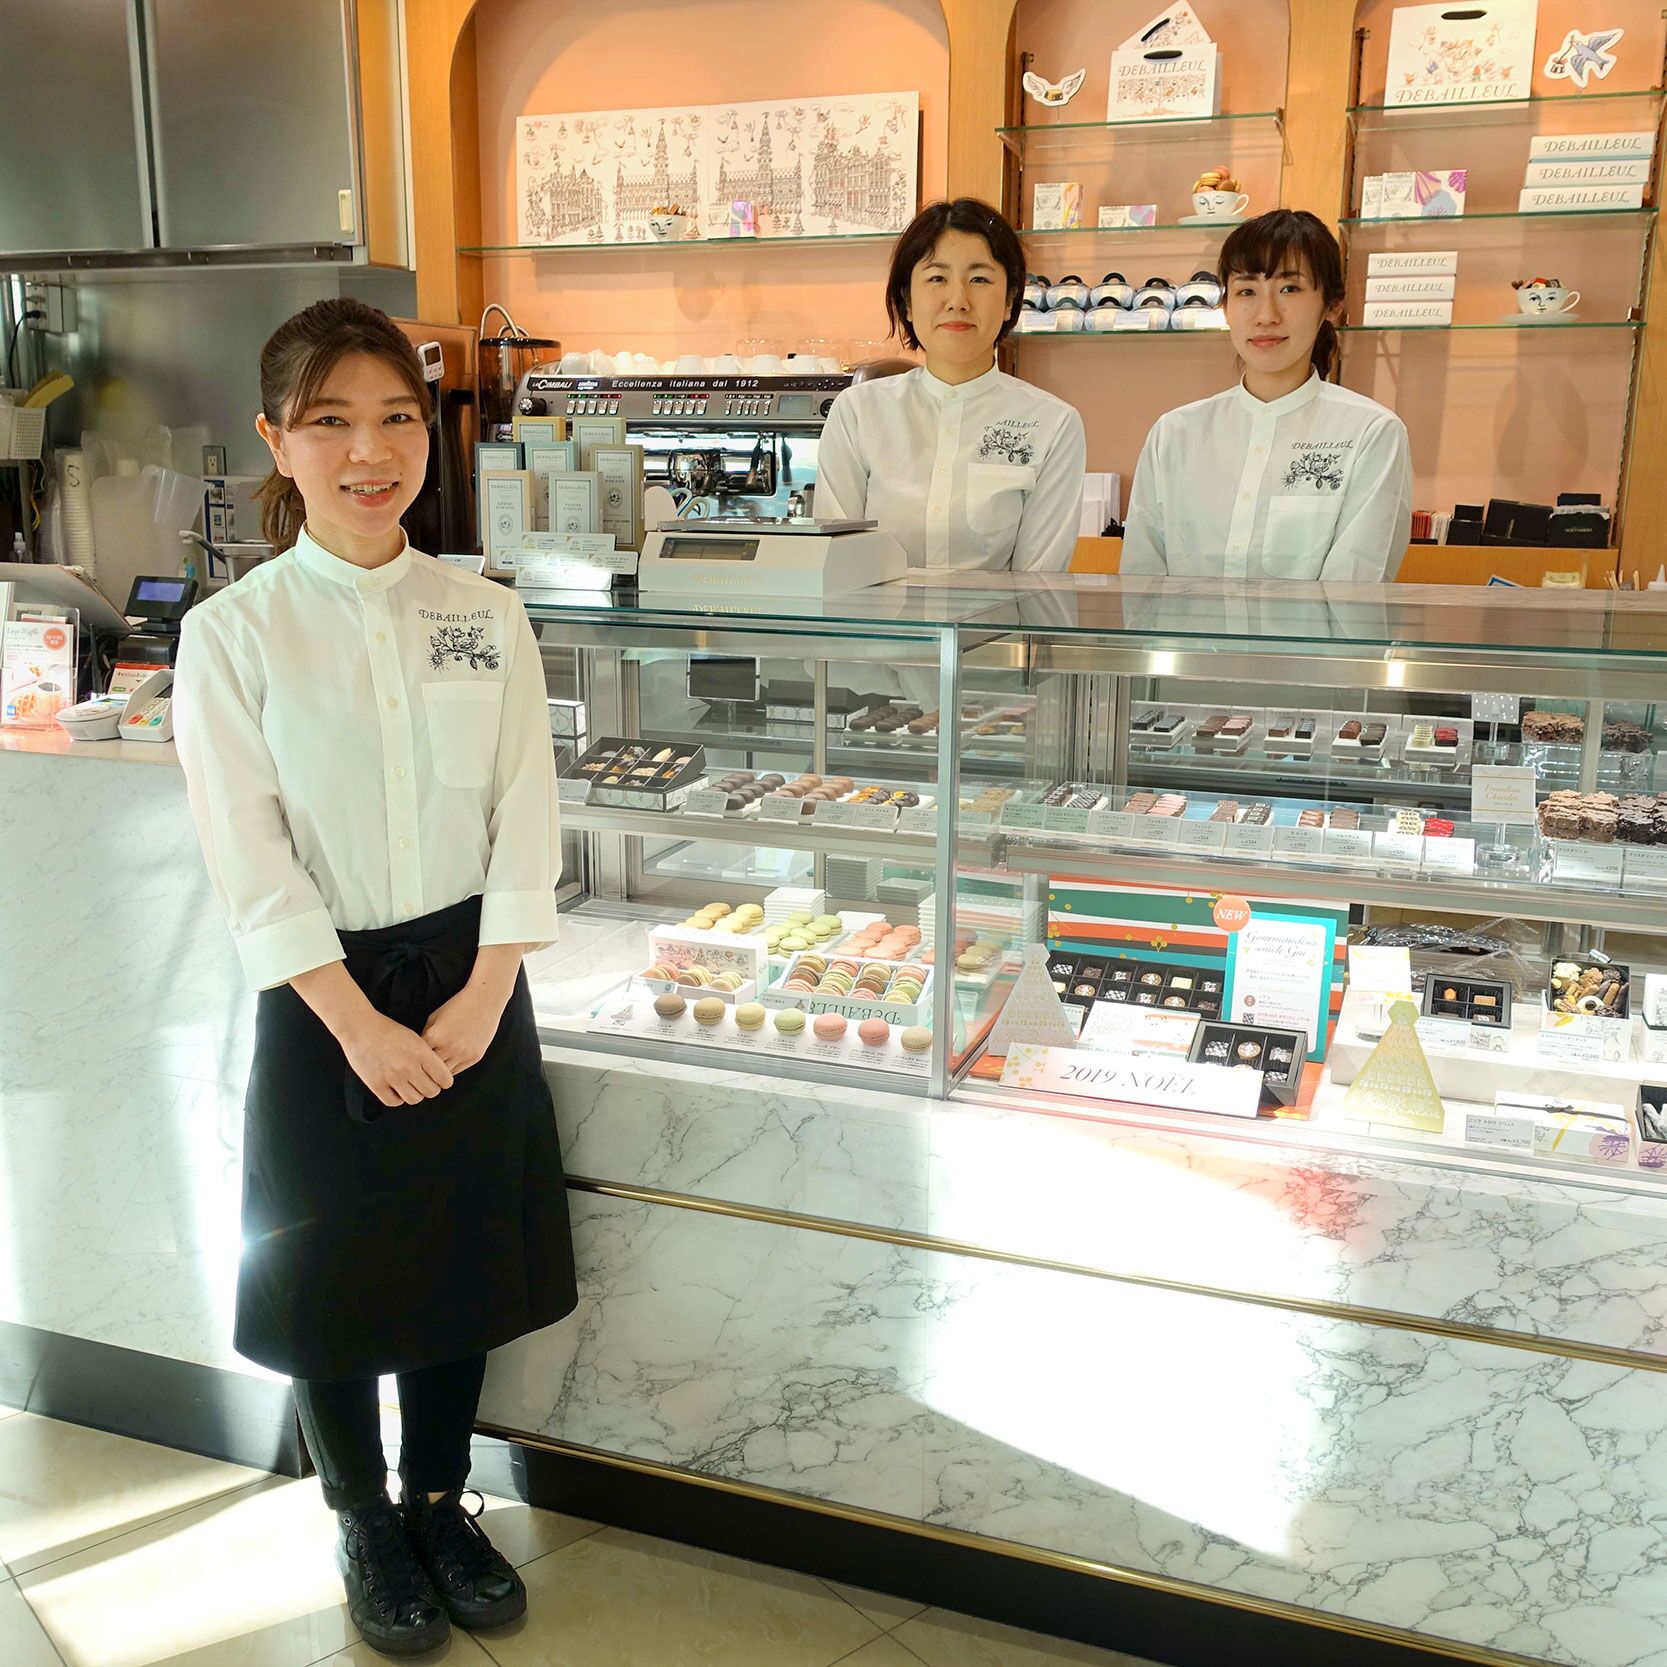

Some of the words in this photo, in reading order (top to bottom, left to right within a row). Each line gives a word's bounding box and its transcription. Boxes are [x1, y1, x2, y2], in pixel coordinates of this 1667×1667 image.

[1120, 60, 1207, 76] DEBAILLEUL
[1395, 83, 1518, 103] DEBAILLEUL
[1544, 138, 1642, 152] DEBAILLEUL
[1540, 165, 1637, 179] DEBAILLEUL
[1533, 191, 1630, 205] DEBAILLEUL
[1377, 257, 1448, 268] DEBAILLEUL
[1374, 282, 1445, 293] DEBAILLEUL
[1372, 307, 1443, 318] DEBAILLEUL
[611, 380, 663, 388] Eccellenza
[669, 379, 706, 388] italiana
[712, 379, 728, 388] dal
[735, 379, 760, 388] 1912
[1291, 440, 1354, 450] DEBAILLEUL
[419, 609, 494, 622] DEBAILLEUL
[1216, 908, 1248, 921] NEW
[810, 1000, 902, 1025] DEBAILLE
[1059, 1064, 1117, 1084] 2019
